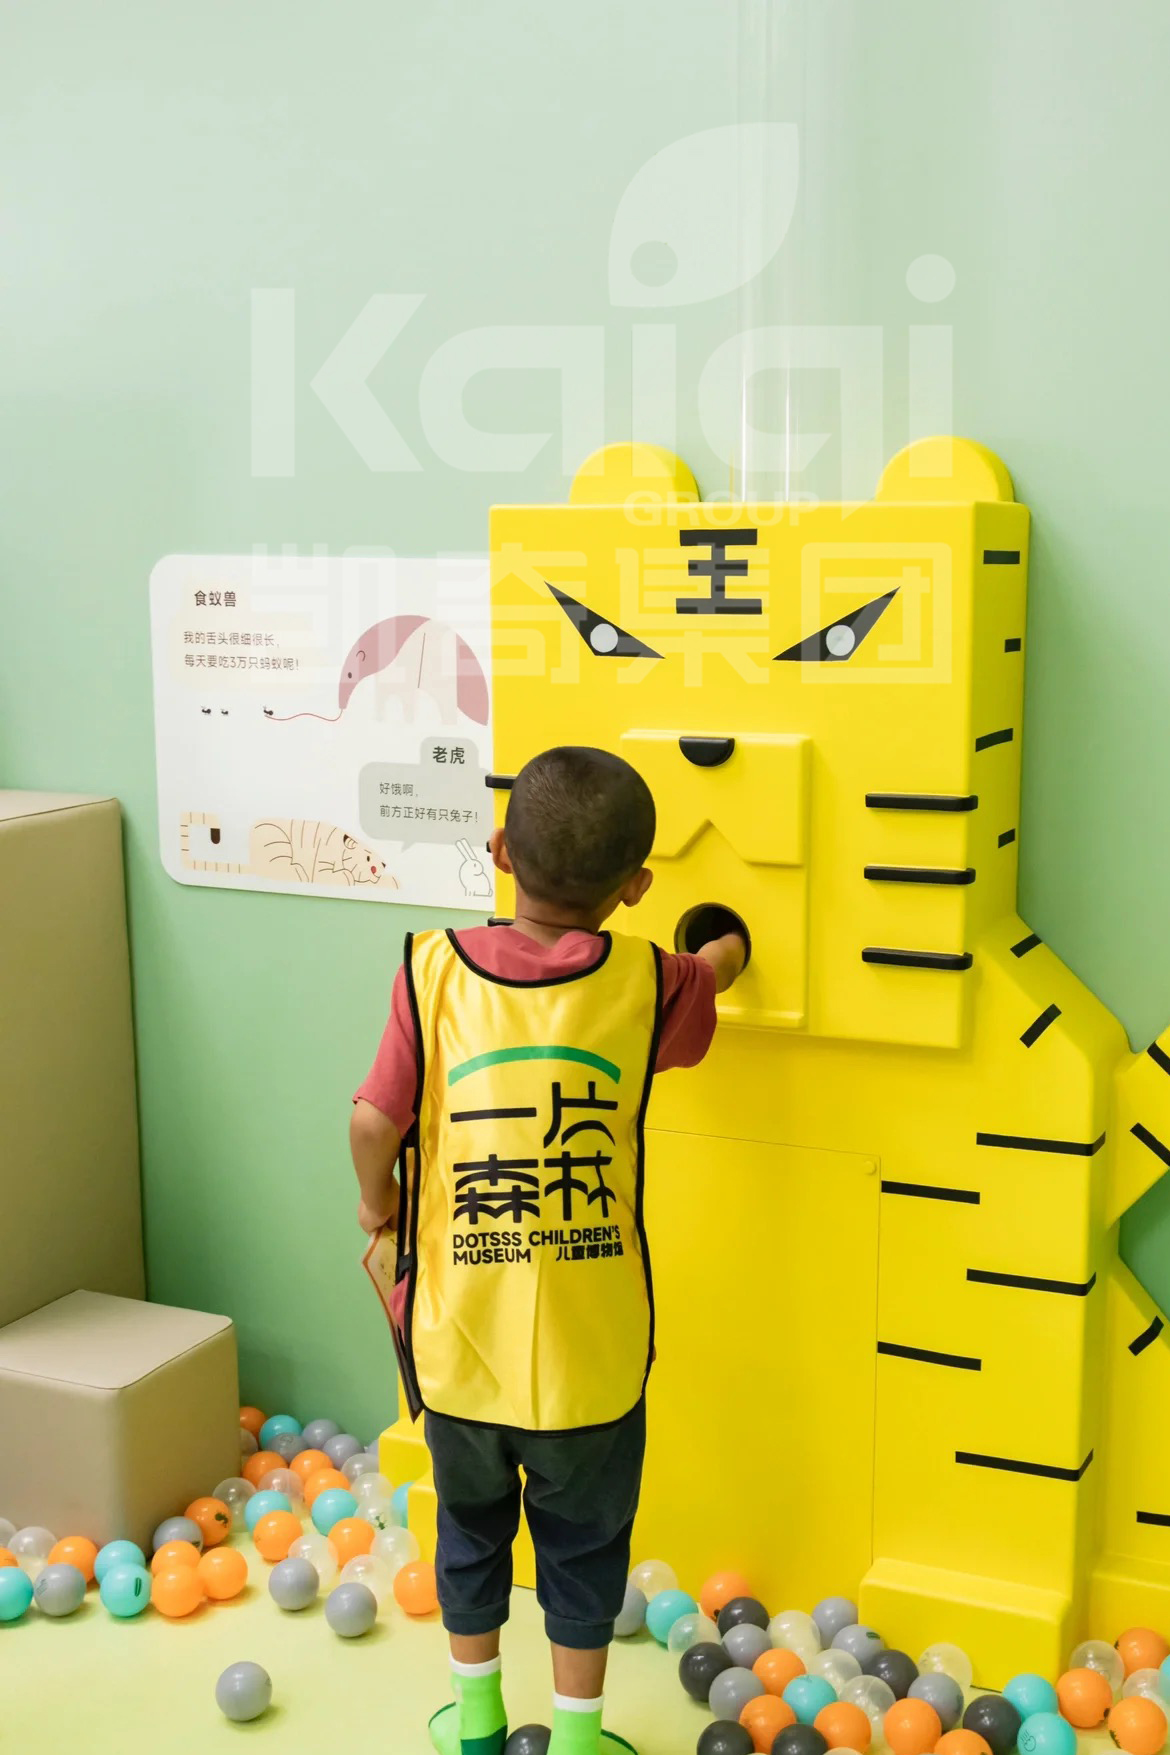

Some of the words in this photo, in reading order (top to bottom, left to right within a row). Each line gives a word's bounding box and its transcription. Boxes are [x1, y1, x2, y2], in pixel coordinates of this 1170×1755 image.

[676, 529, 763, 614] 王
[194, 590, 237, 607] 食蚁兽
[432, 746, 465, 765] 老虎
[450, 1081, 619, 1149] 一片
[453, 1150, 617, 1225] 森林
[453, 1231, 522, 1249] DOTSSS
[528, 1225, 621, 1247] CHILDREN'S
[453, 1248, 531, 1266] MUSEUM
